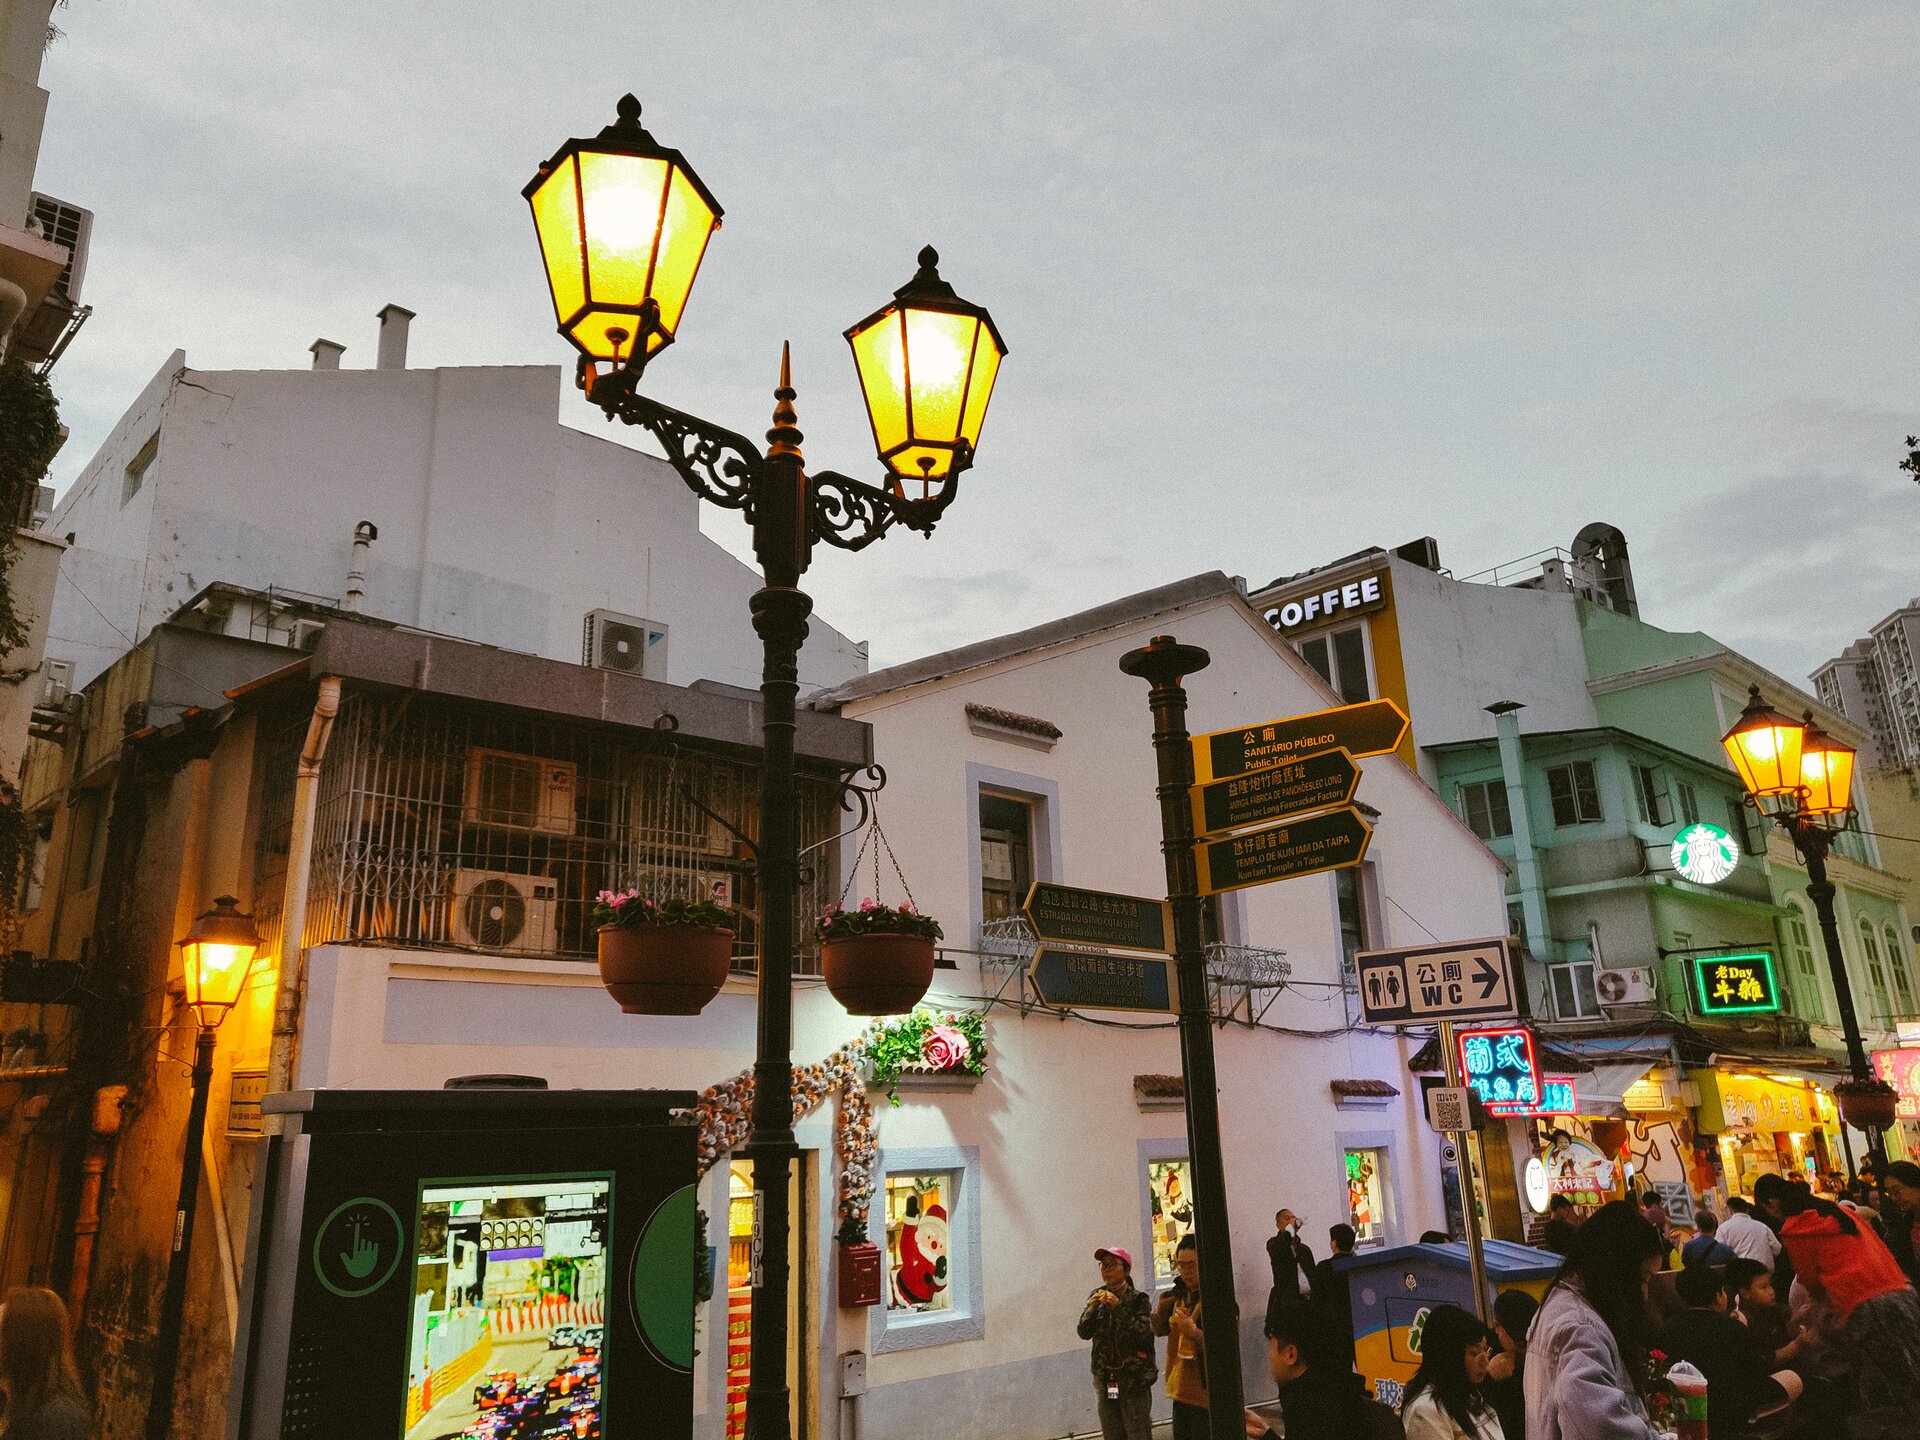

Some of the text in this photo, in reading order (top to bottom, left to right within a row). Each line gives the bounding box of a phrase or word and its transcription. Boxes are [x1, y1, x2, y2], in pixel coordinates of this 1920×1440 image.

[1263, 576, 1380, 630] COFFEE
[1243, 727, 1276, 745] 公廁
[1244, 733, 1335, 758] SANITÁRIO PÚBLICO
[1245, 758, 1272, 770] Public
[1263, 804, 1280, 815] Long
[1316, 789, 1344, 802] Factory
[1236, 853, 1265, 868] TEMPLO
[1266, 850, 1276, 862] DE
[1278, 846, 1295, 859] KUN
[1312, 840, 1325, 851] DA
[1326, 834, 1350, 848] TAIPA
[1267, 861, 1295, 876] Temple
[1304, 856, 1325, 869] Taipa
[1416, 960, 1462, 984] 公廁
